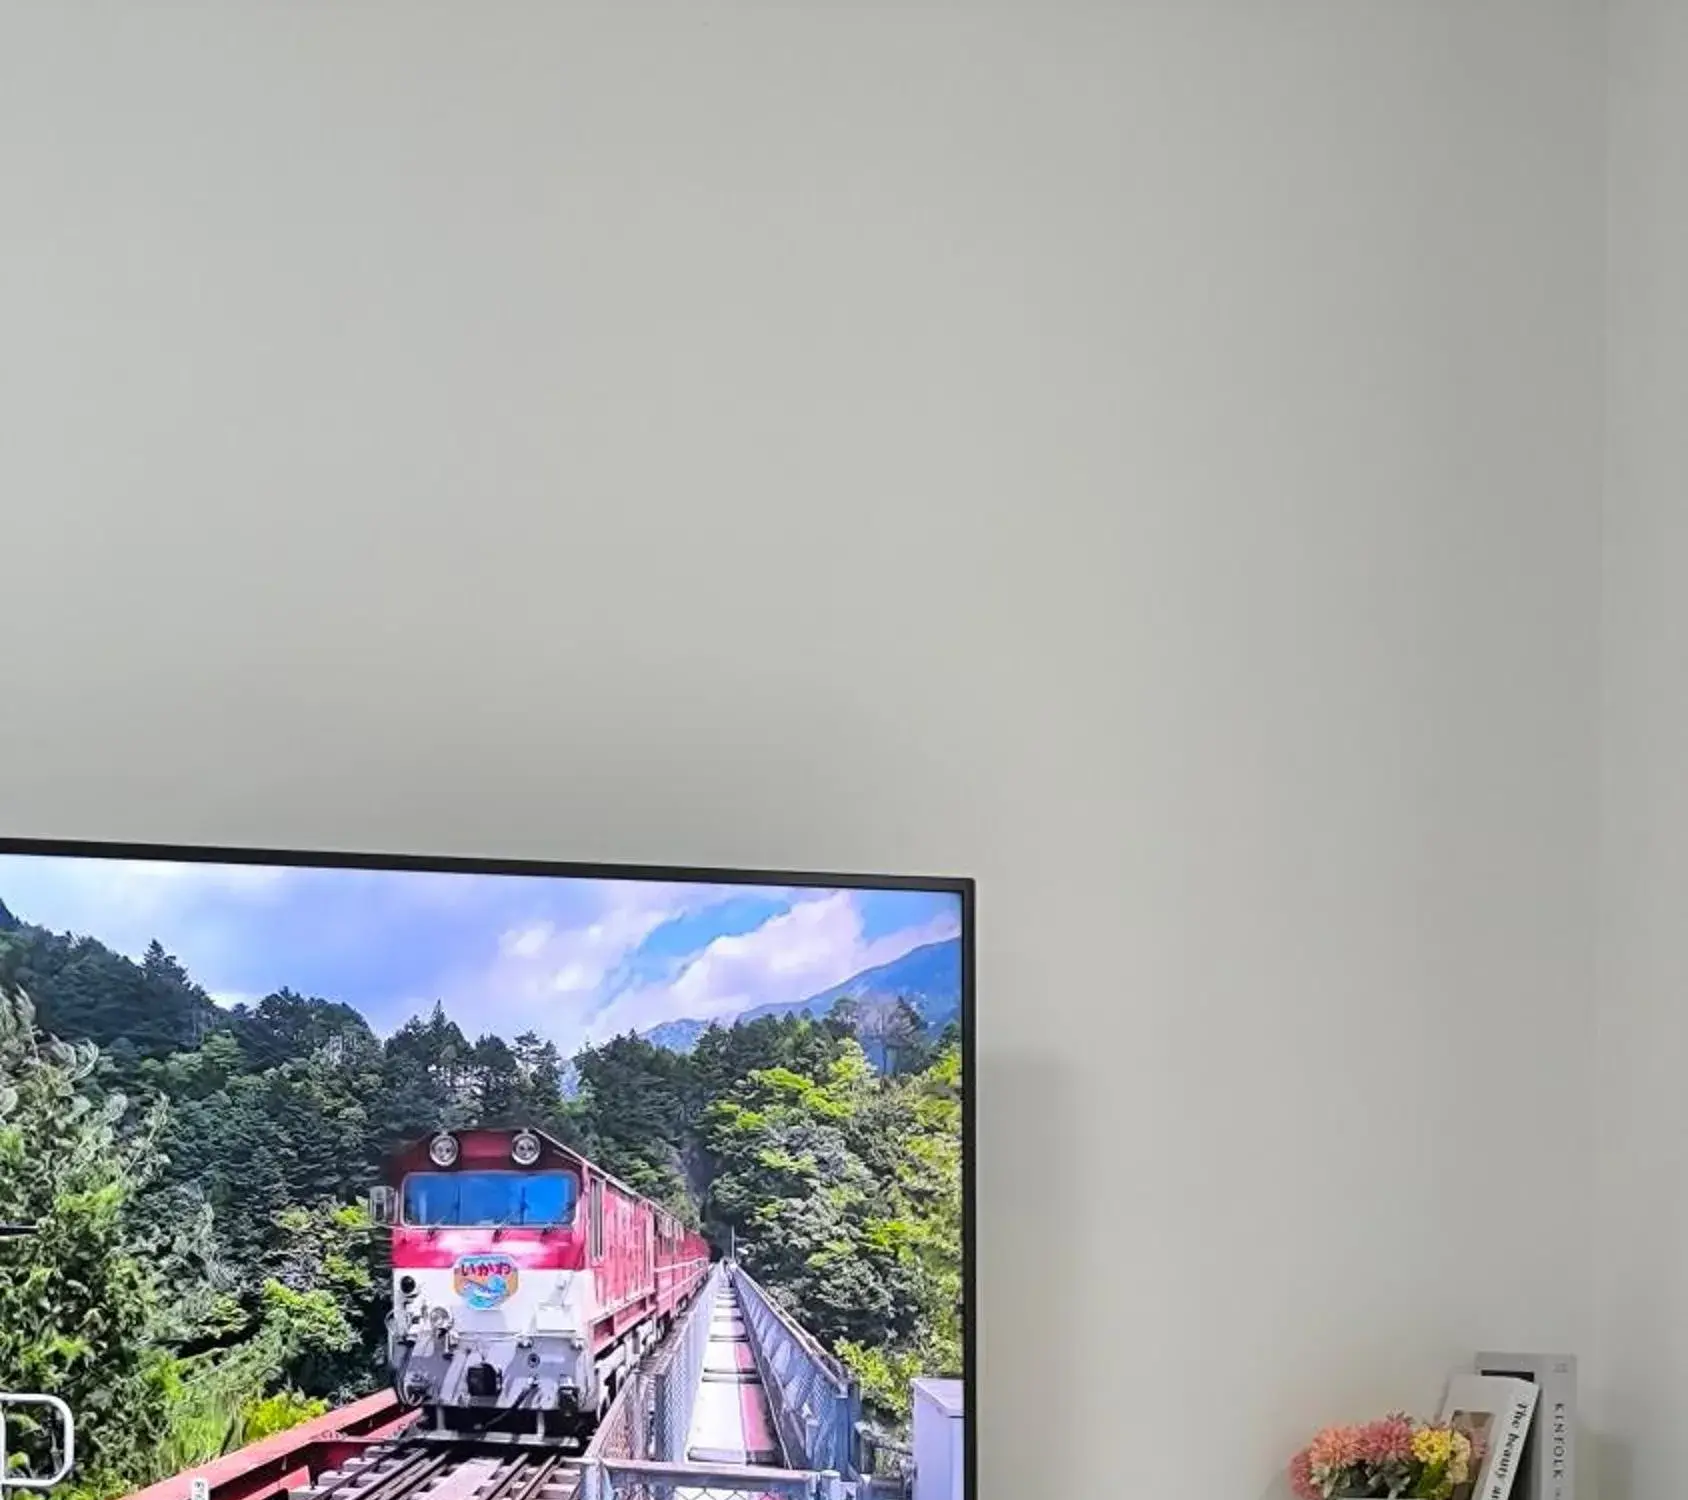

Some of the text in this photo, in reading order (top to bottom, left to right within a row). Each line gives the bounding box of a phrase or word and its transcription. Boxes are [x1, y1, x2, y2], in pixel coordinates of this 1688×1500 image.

[1511, 1403, 1528, 1429] The
[1495, 1433, 1520, 1479] beauty
[1553, 1402, 1566, 1479] KINFOLK
